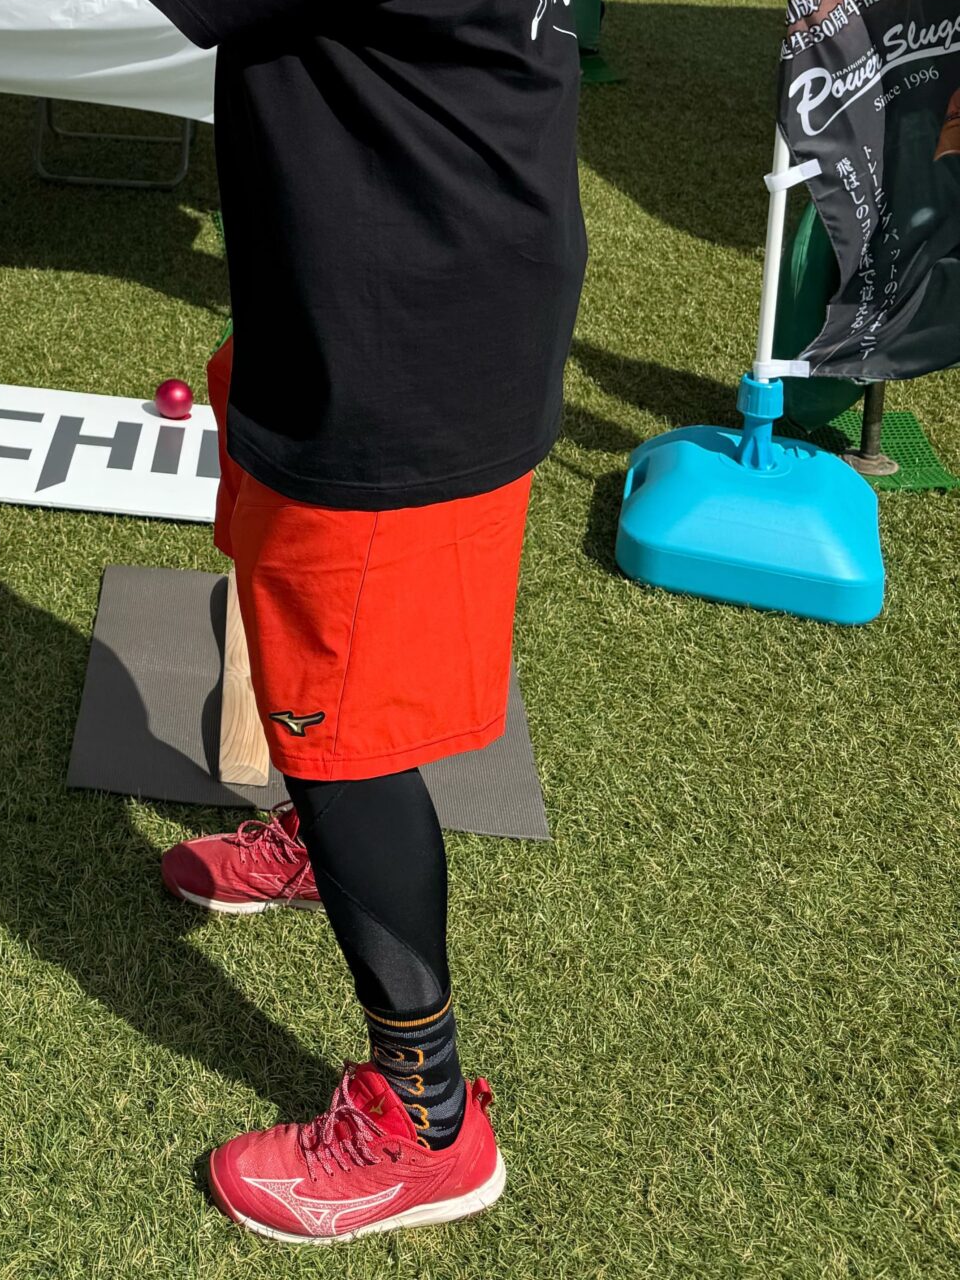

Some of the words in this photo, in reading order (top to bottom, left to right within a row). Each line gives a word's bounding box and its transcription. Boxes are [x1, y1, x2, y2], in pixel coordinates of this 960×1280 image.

[831, 56, 868, 80] TRAINING
[873, 84, 902, 112] Since
[903, 65, 940, 90] 1996
[788, 53, 883, 137] Power
